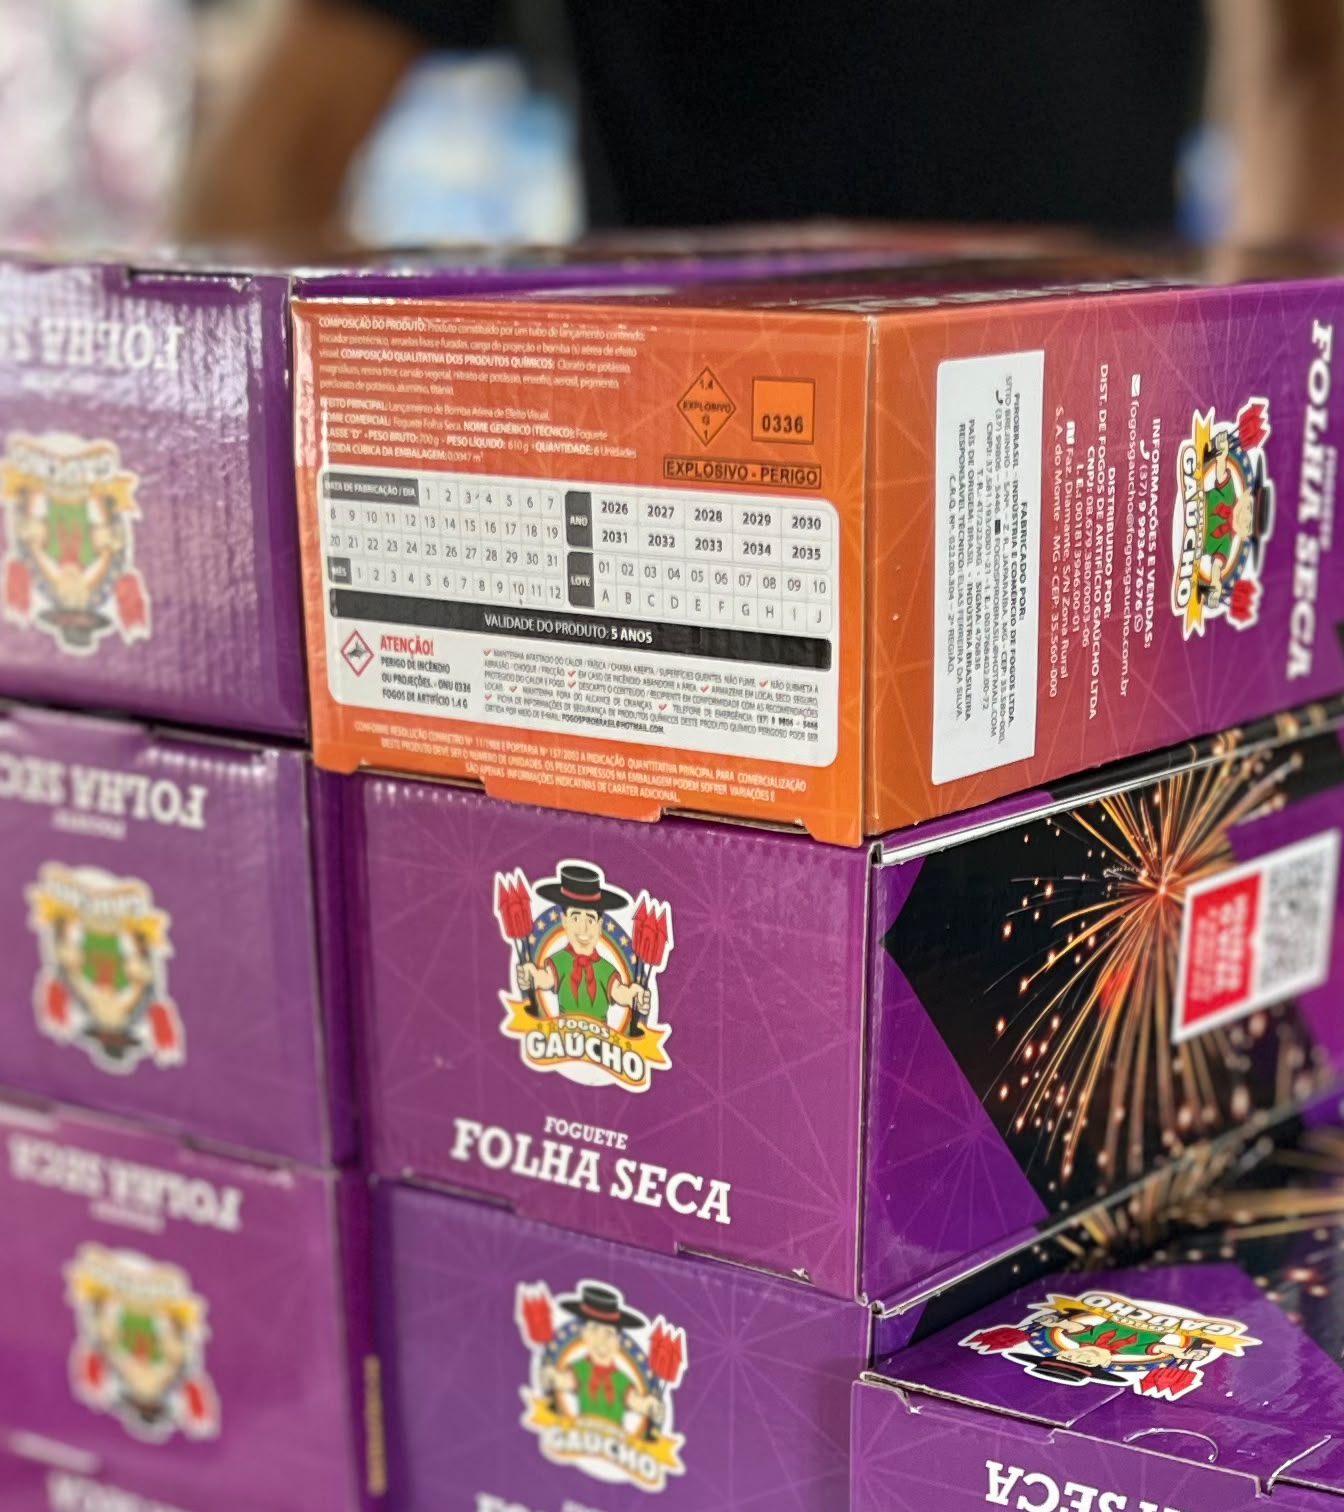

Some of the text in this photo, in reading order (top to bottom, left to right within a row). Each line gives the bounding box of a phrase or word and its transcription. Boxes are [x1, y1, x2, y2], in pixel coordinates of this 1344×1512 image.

[761, 413, 804, 434] 0336
[1299, 319, 1333, 524] FOLHA
[666, 460, 748, 480] EXPLOSIVO
[759, 466, 818, 486] PERIGO
[569, 514, 589, 527] ANO
[600, 499, 822, 531] 2026 2027 2028 2029 2030
[1143, 417, 1161, 649] INFORMAÇÕES E VENDAS:
[601, 529, 821, 561] 2031 2032 2033 2034 2035
[1087, 363, 1109, 720] DIST. DE FOGOS DE ARTIFÍCIO GAÚCHO LTDA
[1102, 466, 1116, 620] DISTRIBUIDO POR:
[1119, 399, 1140, 697] fogosgaucho@fogosgaucho.com.br
[1133, 463, 1148, 611] (37) 9 9934-7676
[569, 574, 591, 587] LOTE
[597, 559, 827, 594] 01 02 03 04 05 06 07 08 09 10
[1017, 500, 1028, 621] FABRICADO POR:
[1287, 530, 1320, 682] SECA
[379, 634, 434, 657] ATENÇÃO!
[483, 612, 653, 644] VALIDADE DO PRODUTO: 5 ANOS
[71, 766, 208, 830] FOLHA
[558, 1018, 609, 1037] FOGOS
[526, 1030, 646, 1081] GAÚCHO
[544, 1117, 629, 1150] FOGUETE
[450, 1119, 732, 1225] FOLHA SECA
[1083, 1294, 1238, 1337] GAÚCHO
